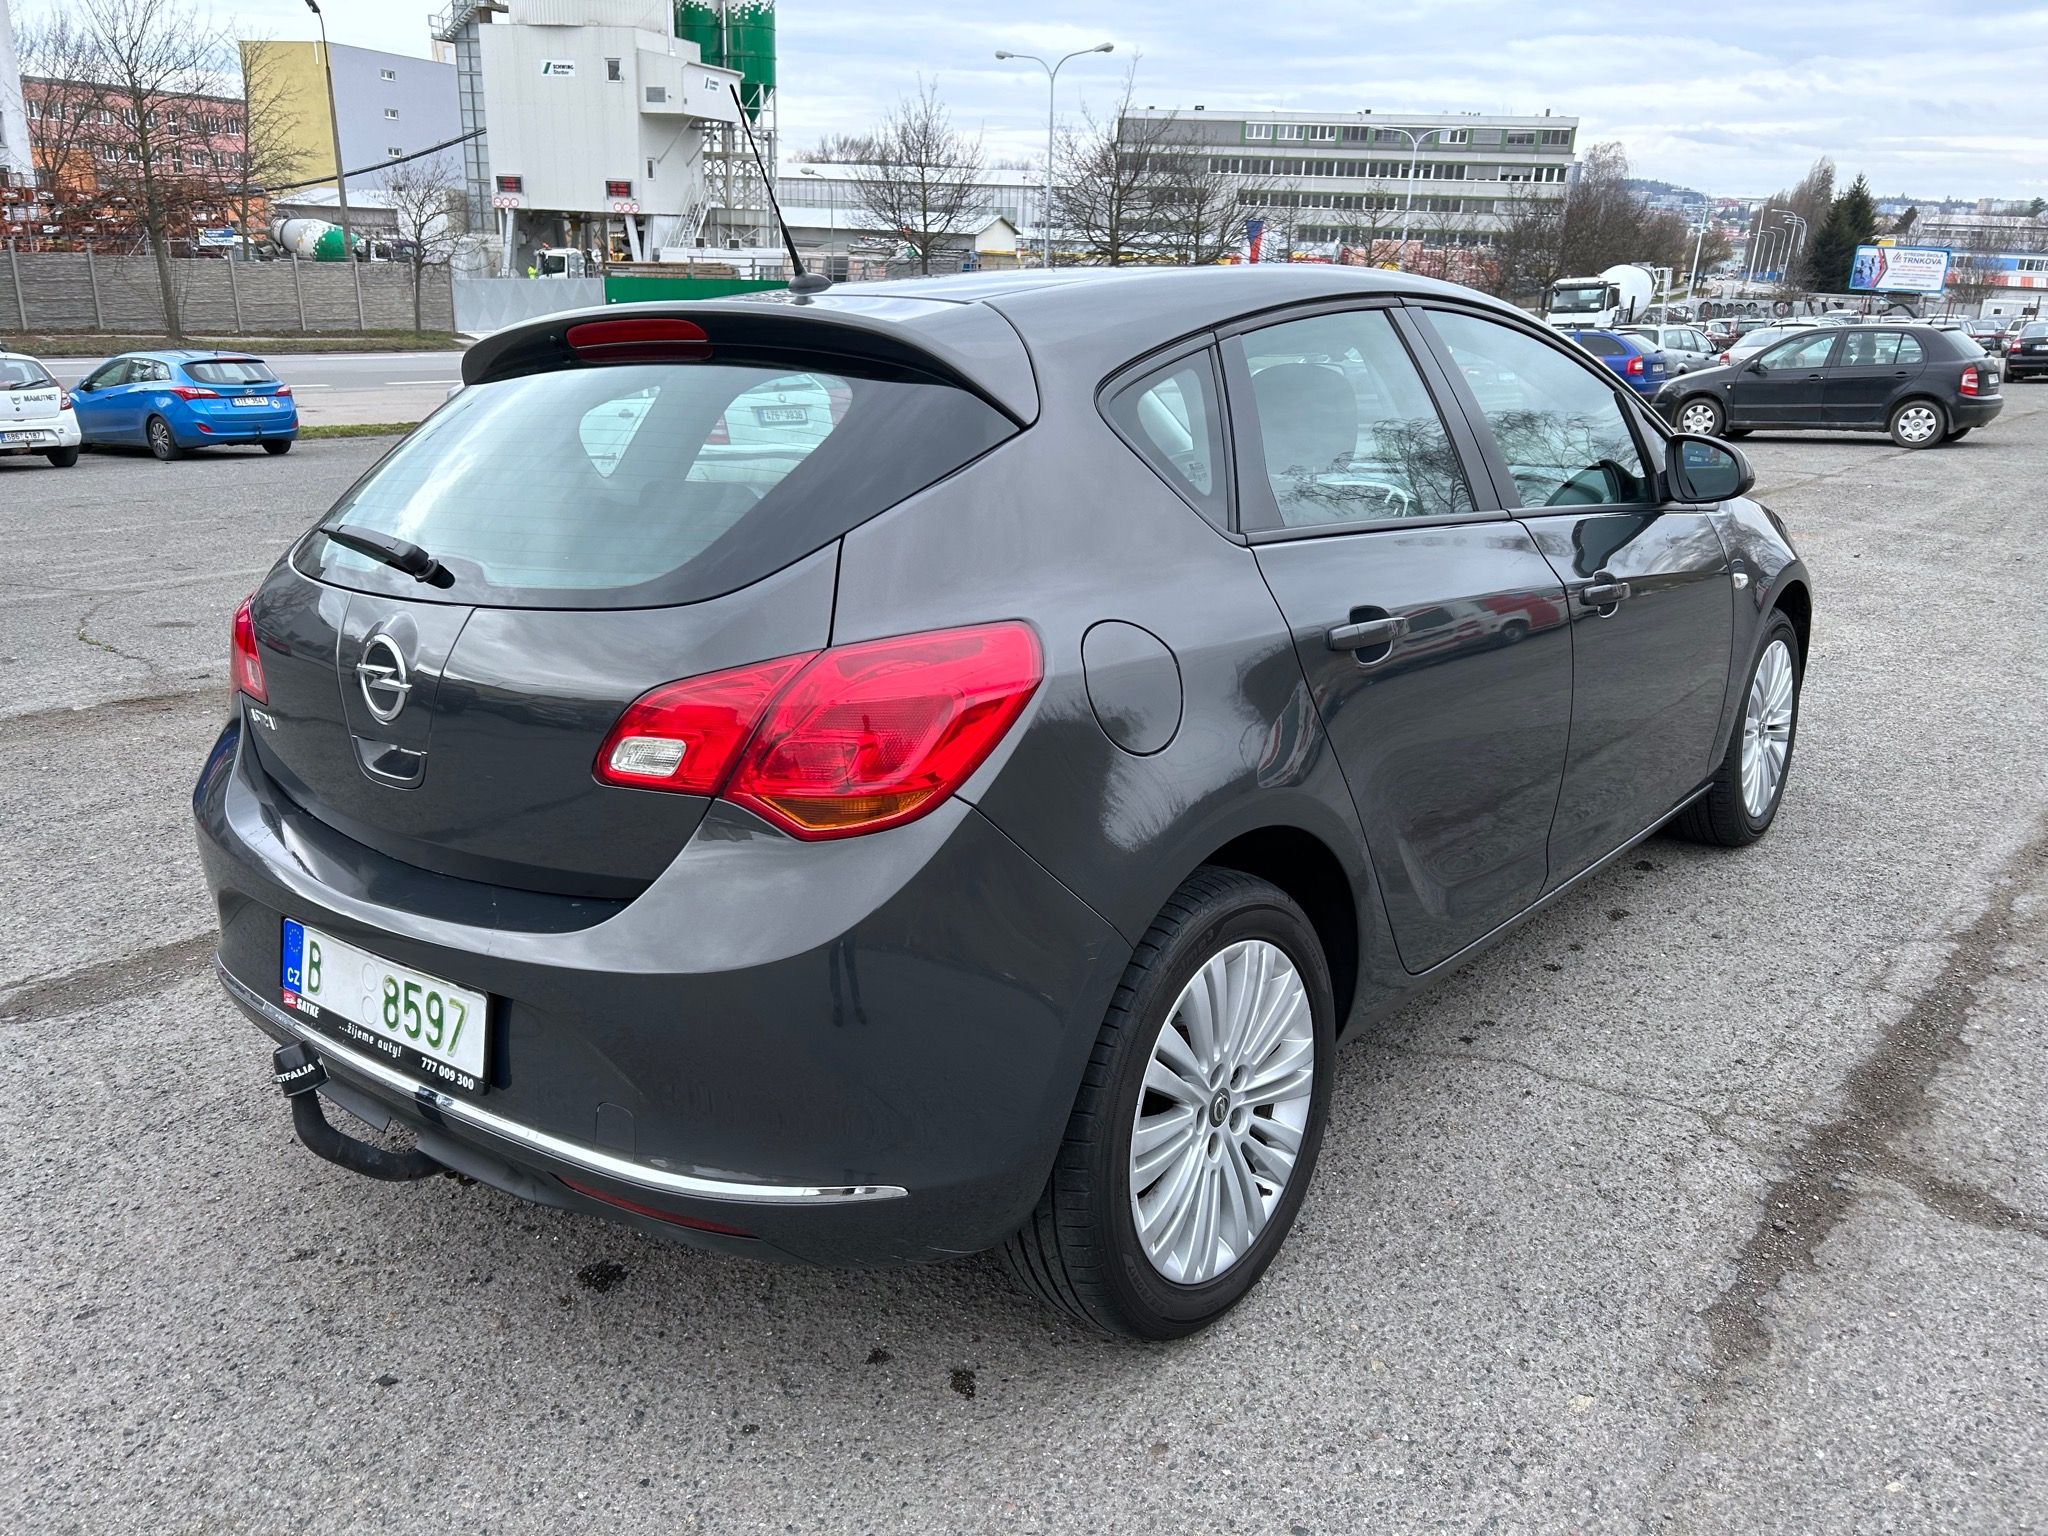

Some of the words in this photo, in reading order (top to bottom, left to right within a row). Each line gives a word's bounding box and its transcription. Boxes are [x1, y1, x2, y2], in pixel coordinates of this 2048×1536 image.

[1903, 256, 1942, 265] TRNKOVA
[287, 966, 300, 986] CZ
[308, 940, 322, 993] B
[382, 975, 468, 1056] 8597
[377, 1039, 402, 1059] auty!
[421, 1057, 438, 1073] 777
[439, 1065, 456, 1082] 009
[457, 1073, 475, 1091] 300
